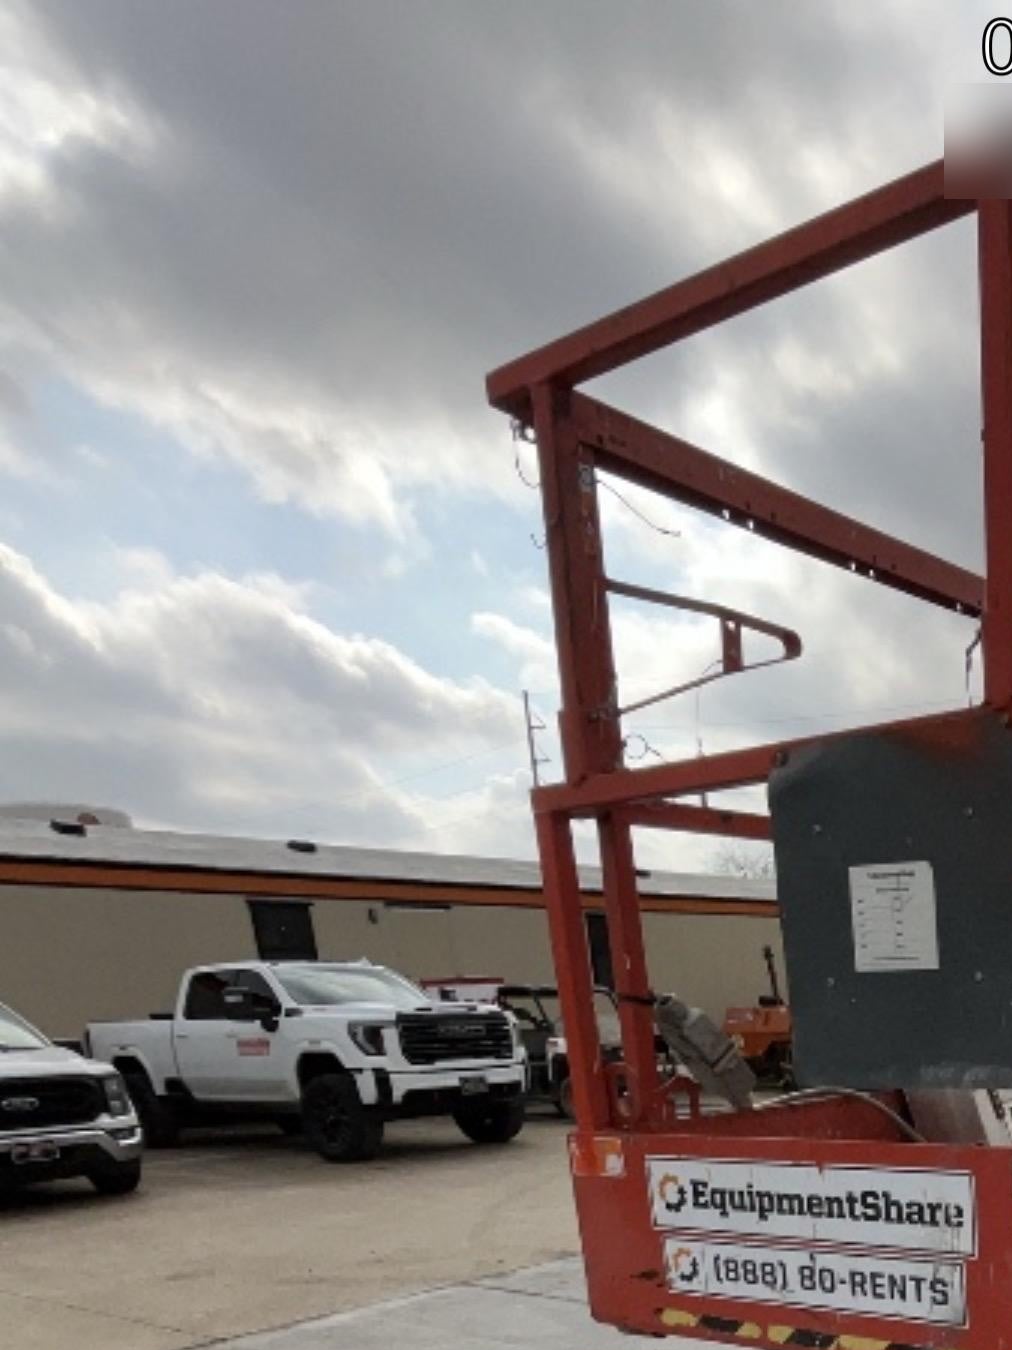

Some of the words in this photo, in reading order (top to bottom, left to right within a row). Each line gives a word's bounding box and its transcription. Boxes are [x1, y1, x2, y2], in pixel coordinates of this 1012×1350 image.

[689, 1178, 965, 1229] EquipmentShare
[712, 1253, 789, 1292] (888)
[799, 1265, 950, 1306] 80-RENTS
